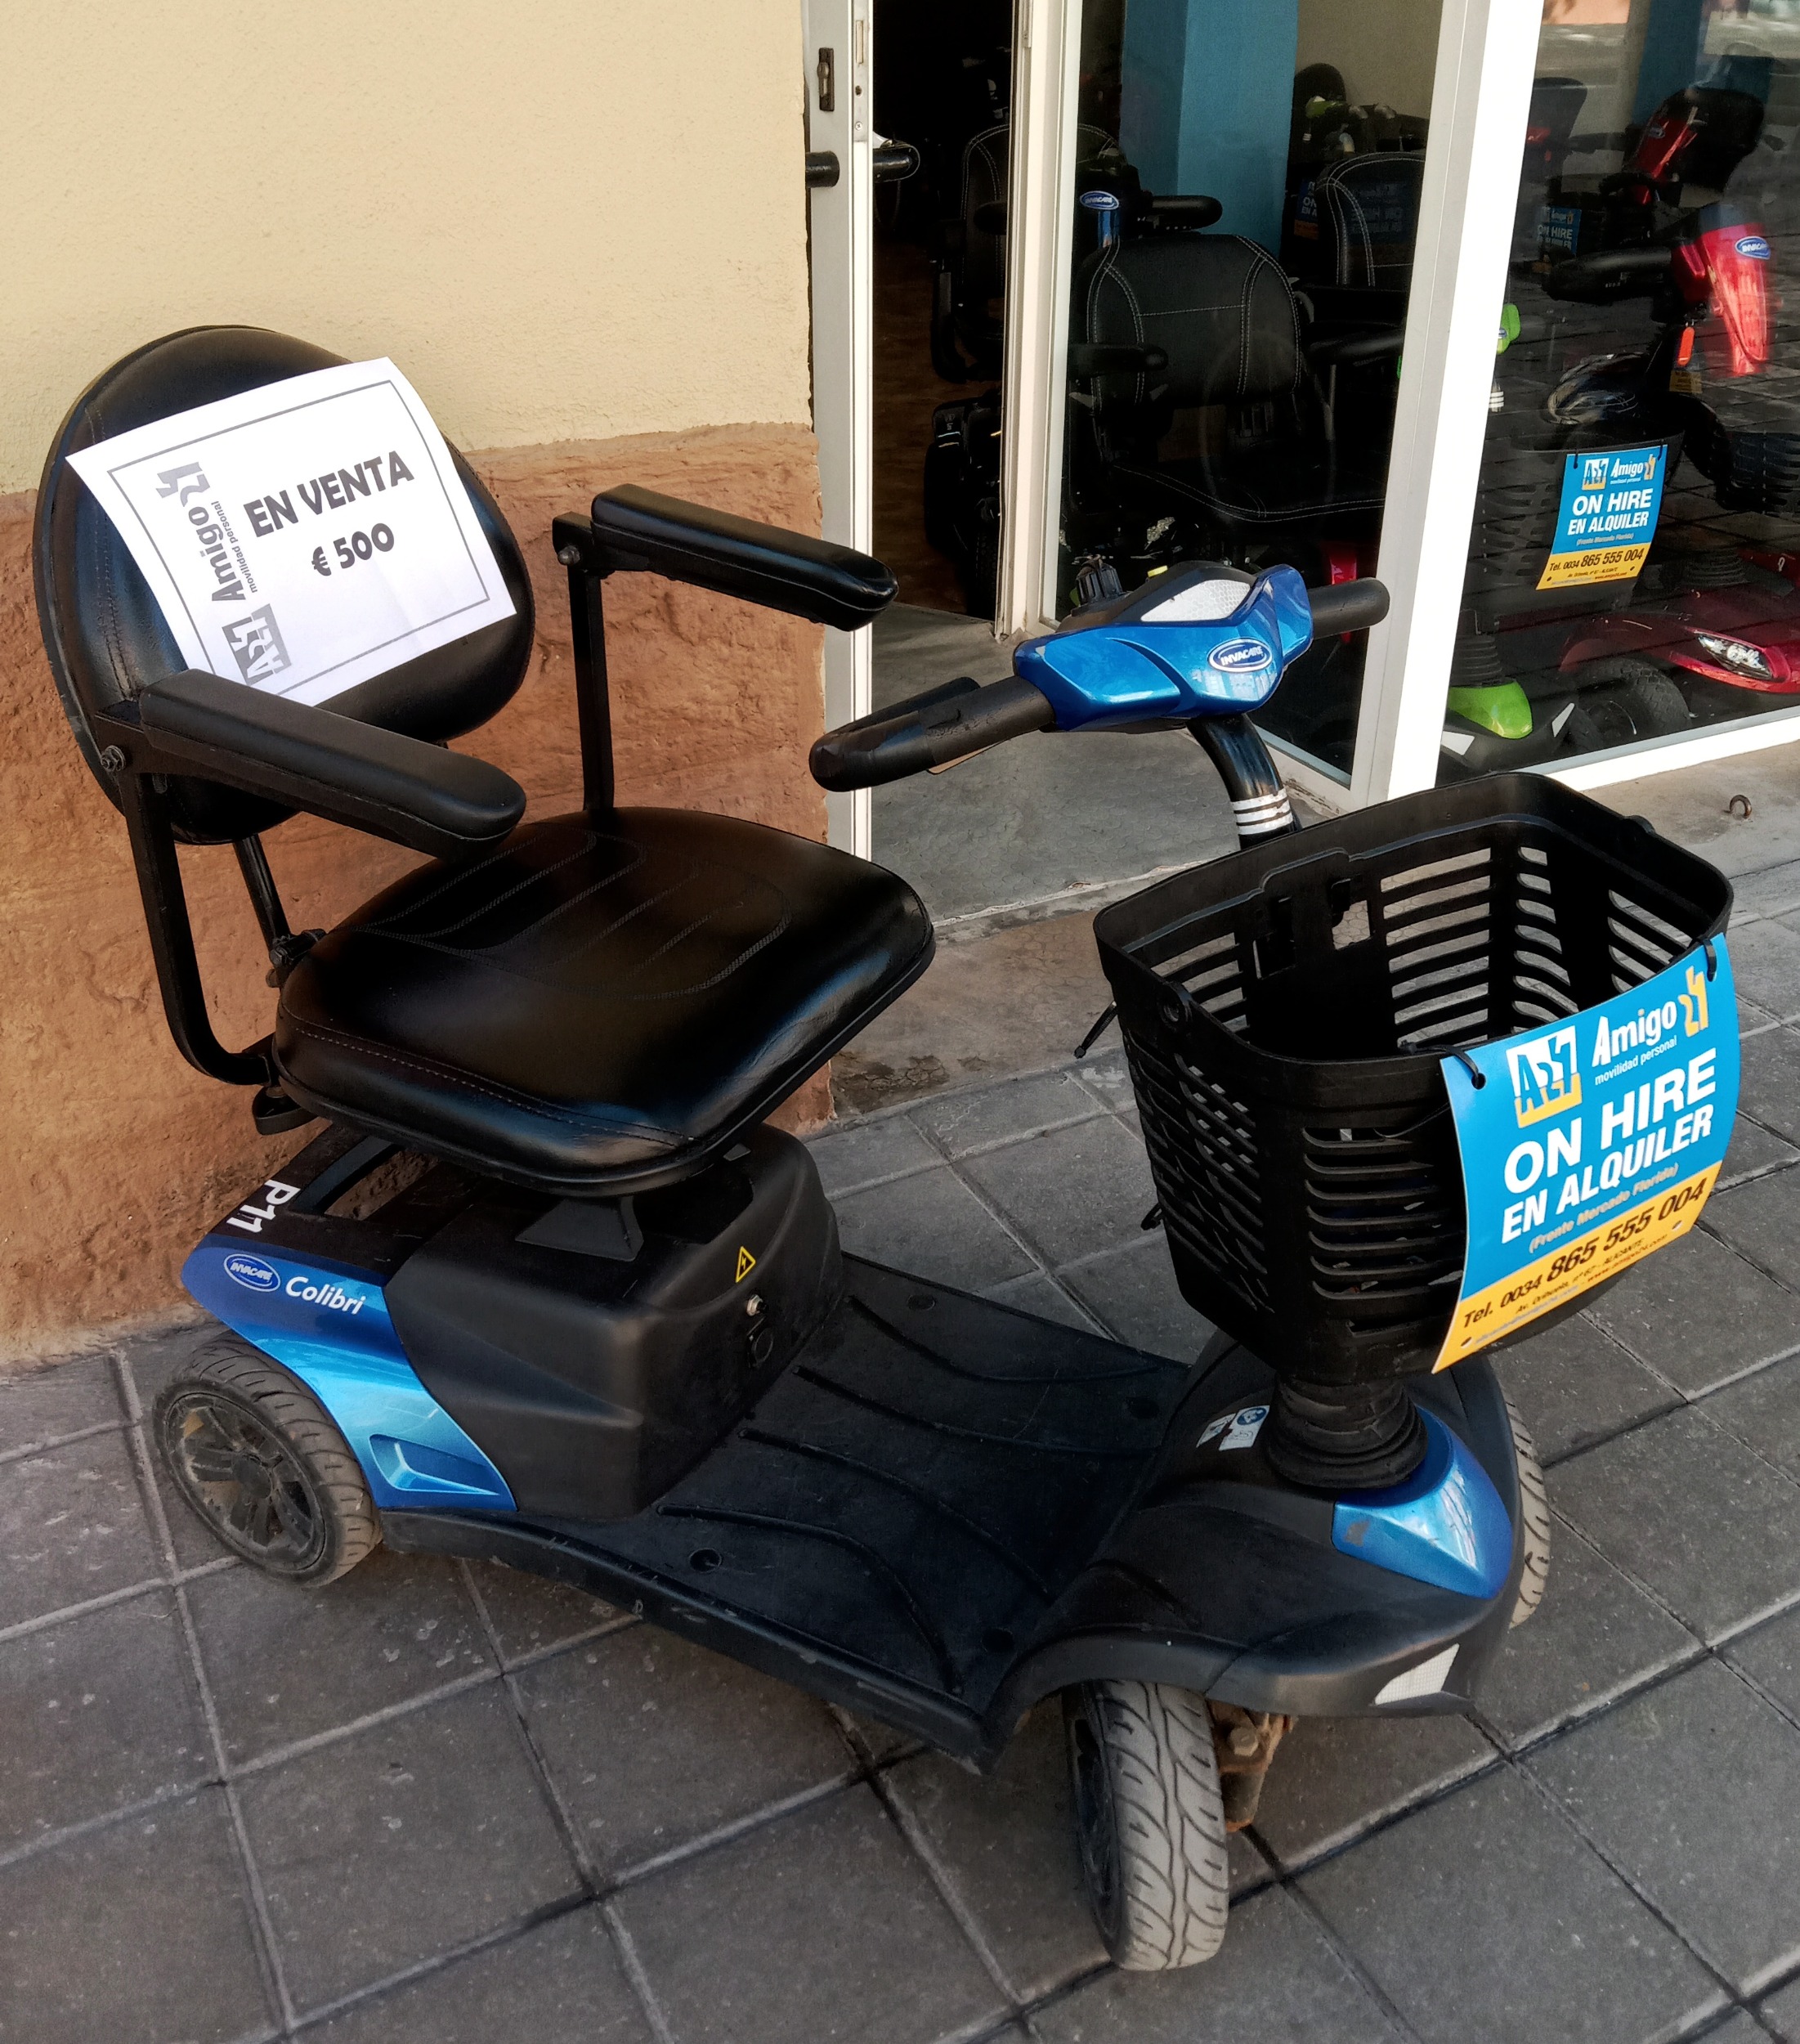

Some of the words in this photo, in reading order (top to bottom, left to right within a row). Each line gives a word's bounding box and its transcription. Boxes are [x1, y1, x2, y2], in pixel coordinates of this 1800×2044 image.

[1610, 458, 1644, 477] Amigo
[243, 490, 299, 538] EN
[297, 450, 415, 515] VENTA
[1572, 494, 1603, 516] ON
[1607, 488, 1654, 513] HIRE
[211, 500, 240, 545] personal
[1567, 518, 1587, 536] EN
[1587, 511, 1650, 533] ALQUILER
[188, 505, 246, 602] Amigo
[231, 545, 258, 594] movilidad
[1549, 562, 1561, 572] Tel.
[1563, 560, 1580, 570] 0034
[1581, 554, 1602, 567] 865
[1602, 550, 1623, 564] 555
[1623, 548, 1646, 562] 004
[1220, 646, 1263, 666] INVACARE
[1592, 1001, 1677, 1067] Amigo
[1595, 1053, 1638, 1086] movilidad
[1640, 1035, 1677, 1066] personal
[1504, 1117, 1582, 1194] ON
[1601, 1047, 1716, 1150] HIRE
[1502, 1188, 1547, 1244] EN
[1556, 1104, 1714, 1215] ALQUILER
[226, 1179, 301, 1233] P11
[1464, 1302, 1493, 1328] Tel.
[1500, 1275, 1543, 1308] 0034
[1547, 1237, 1600, 1282] 865
[1603, 1206, 1654, 1251] 555
[1658, 1177, 1708, 1221] 004
[230, 1262, 273, 1282] INVACARE
[286, 1276, 366, 1315] Colibri
